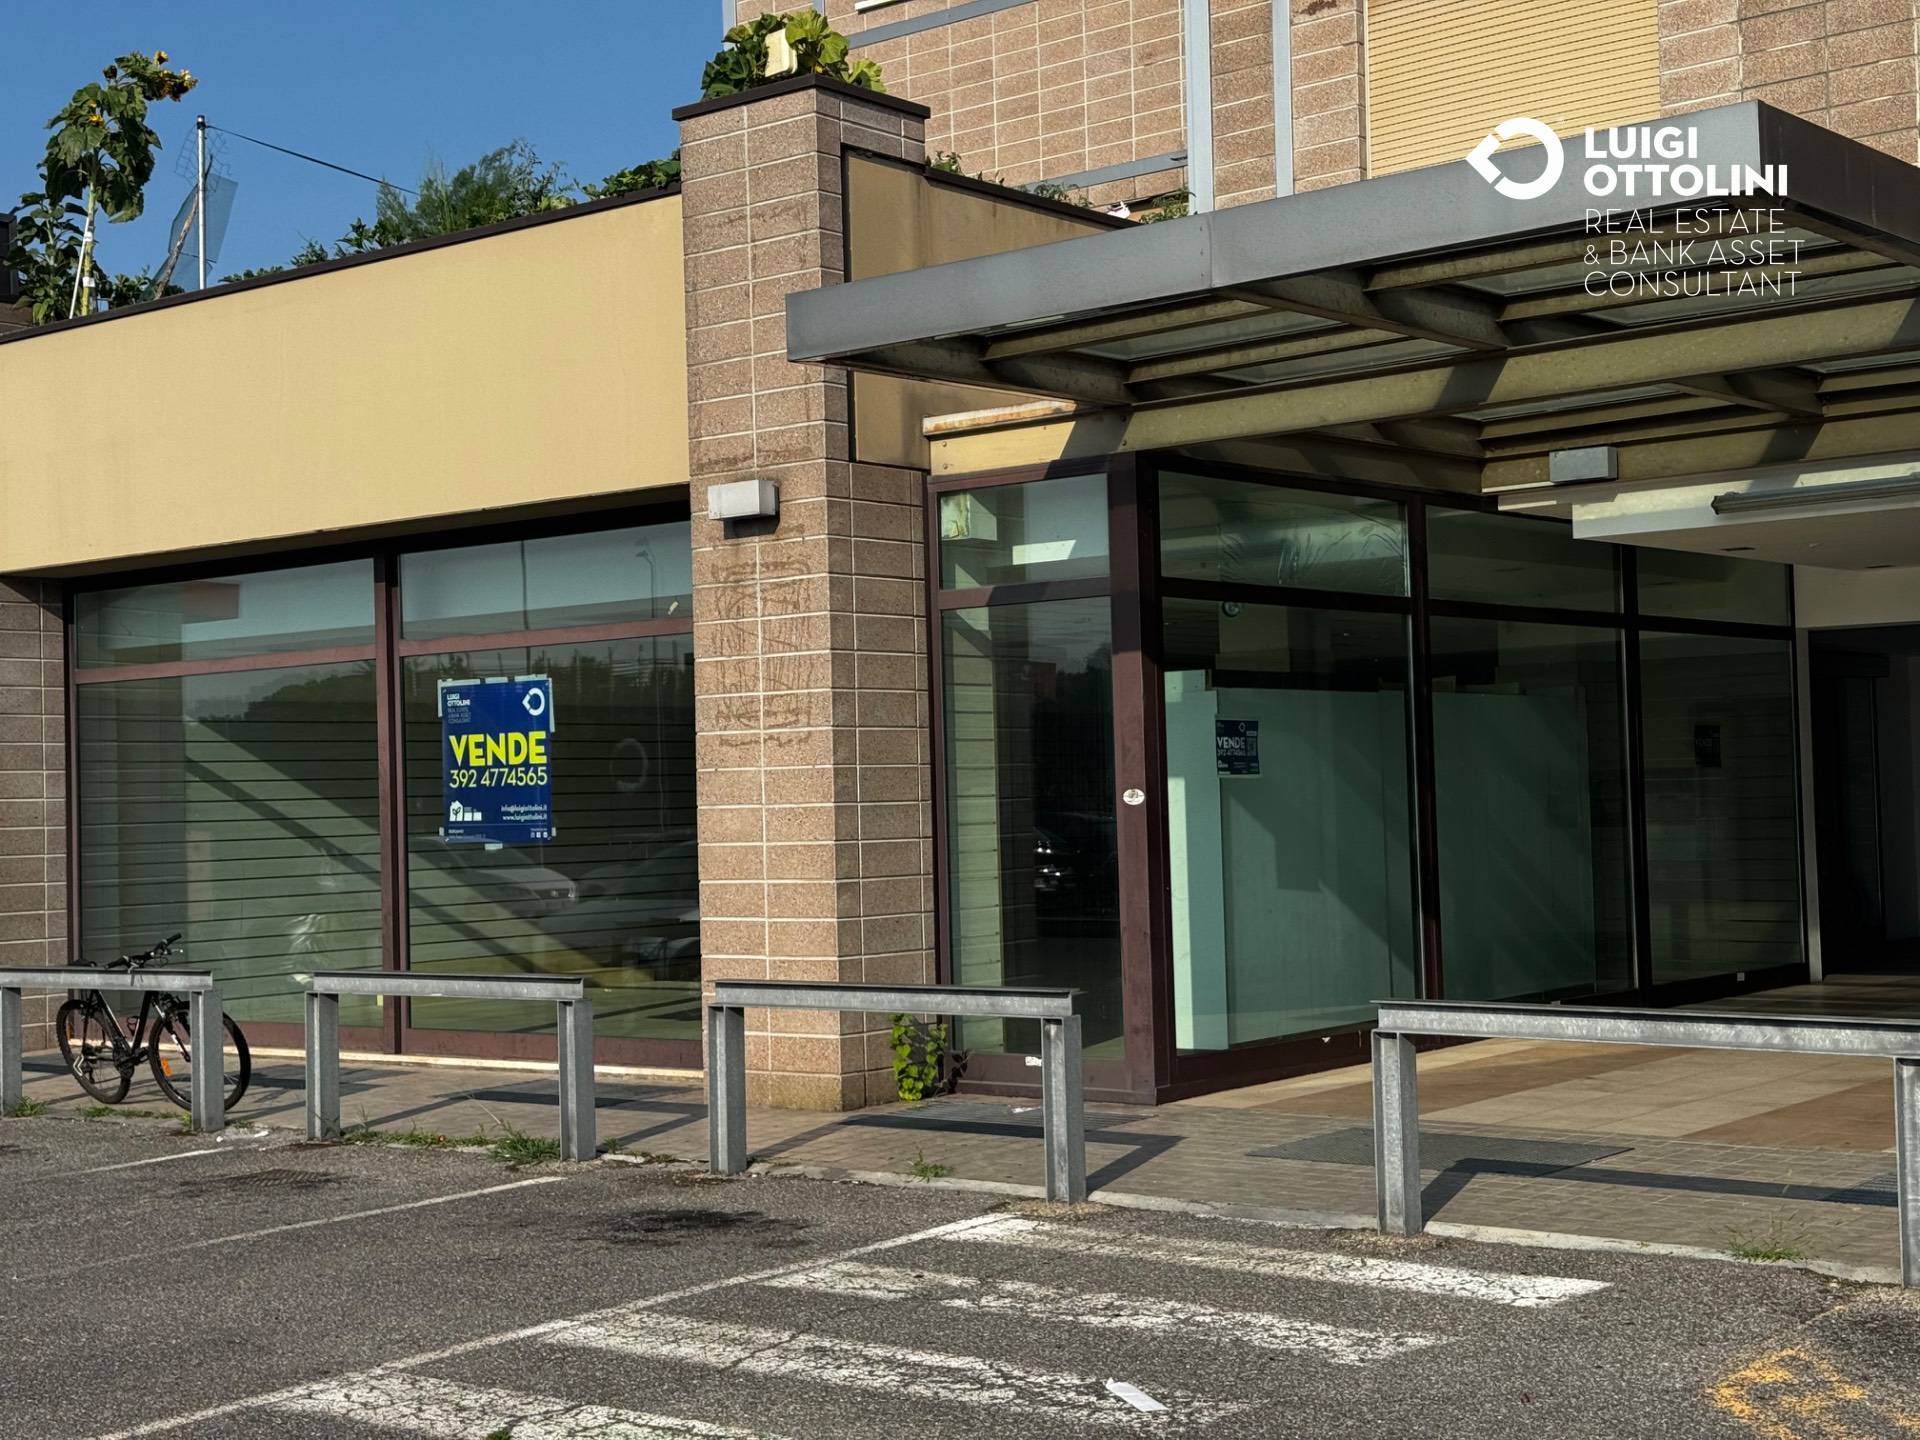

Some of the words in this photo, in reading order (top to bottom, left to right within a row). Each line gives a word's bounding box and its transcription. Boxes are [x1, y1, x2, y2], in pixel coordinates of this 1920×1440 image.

[449, 731, 547, 768] VENDE
[1217, 736, 1246, 749] VENDE
[449, 769, 477, 789] 392
[481, 767, 548, 788] 4774565
